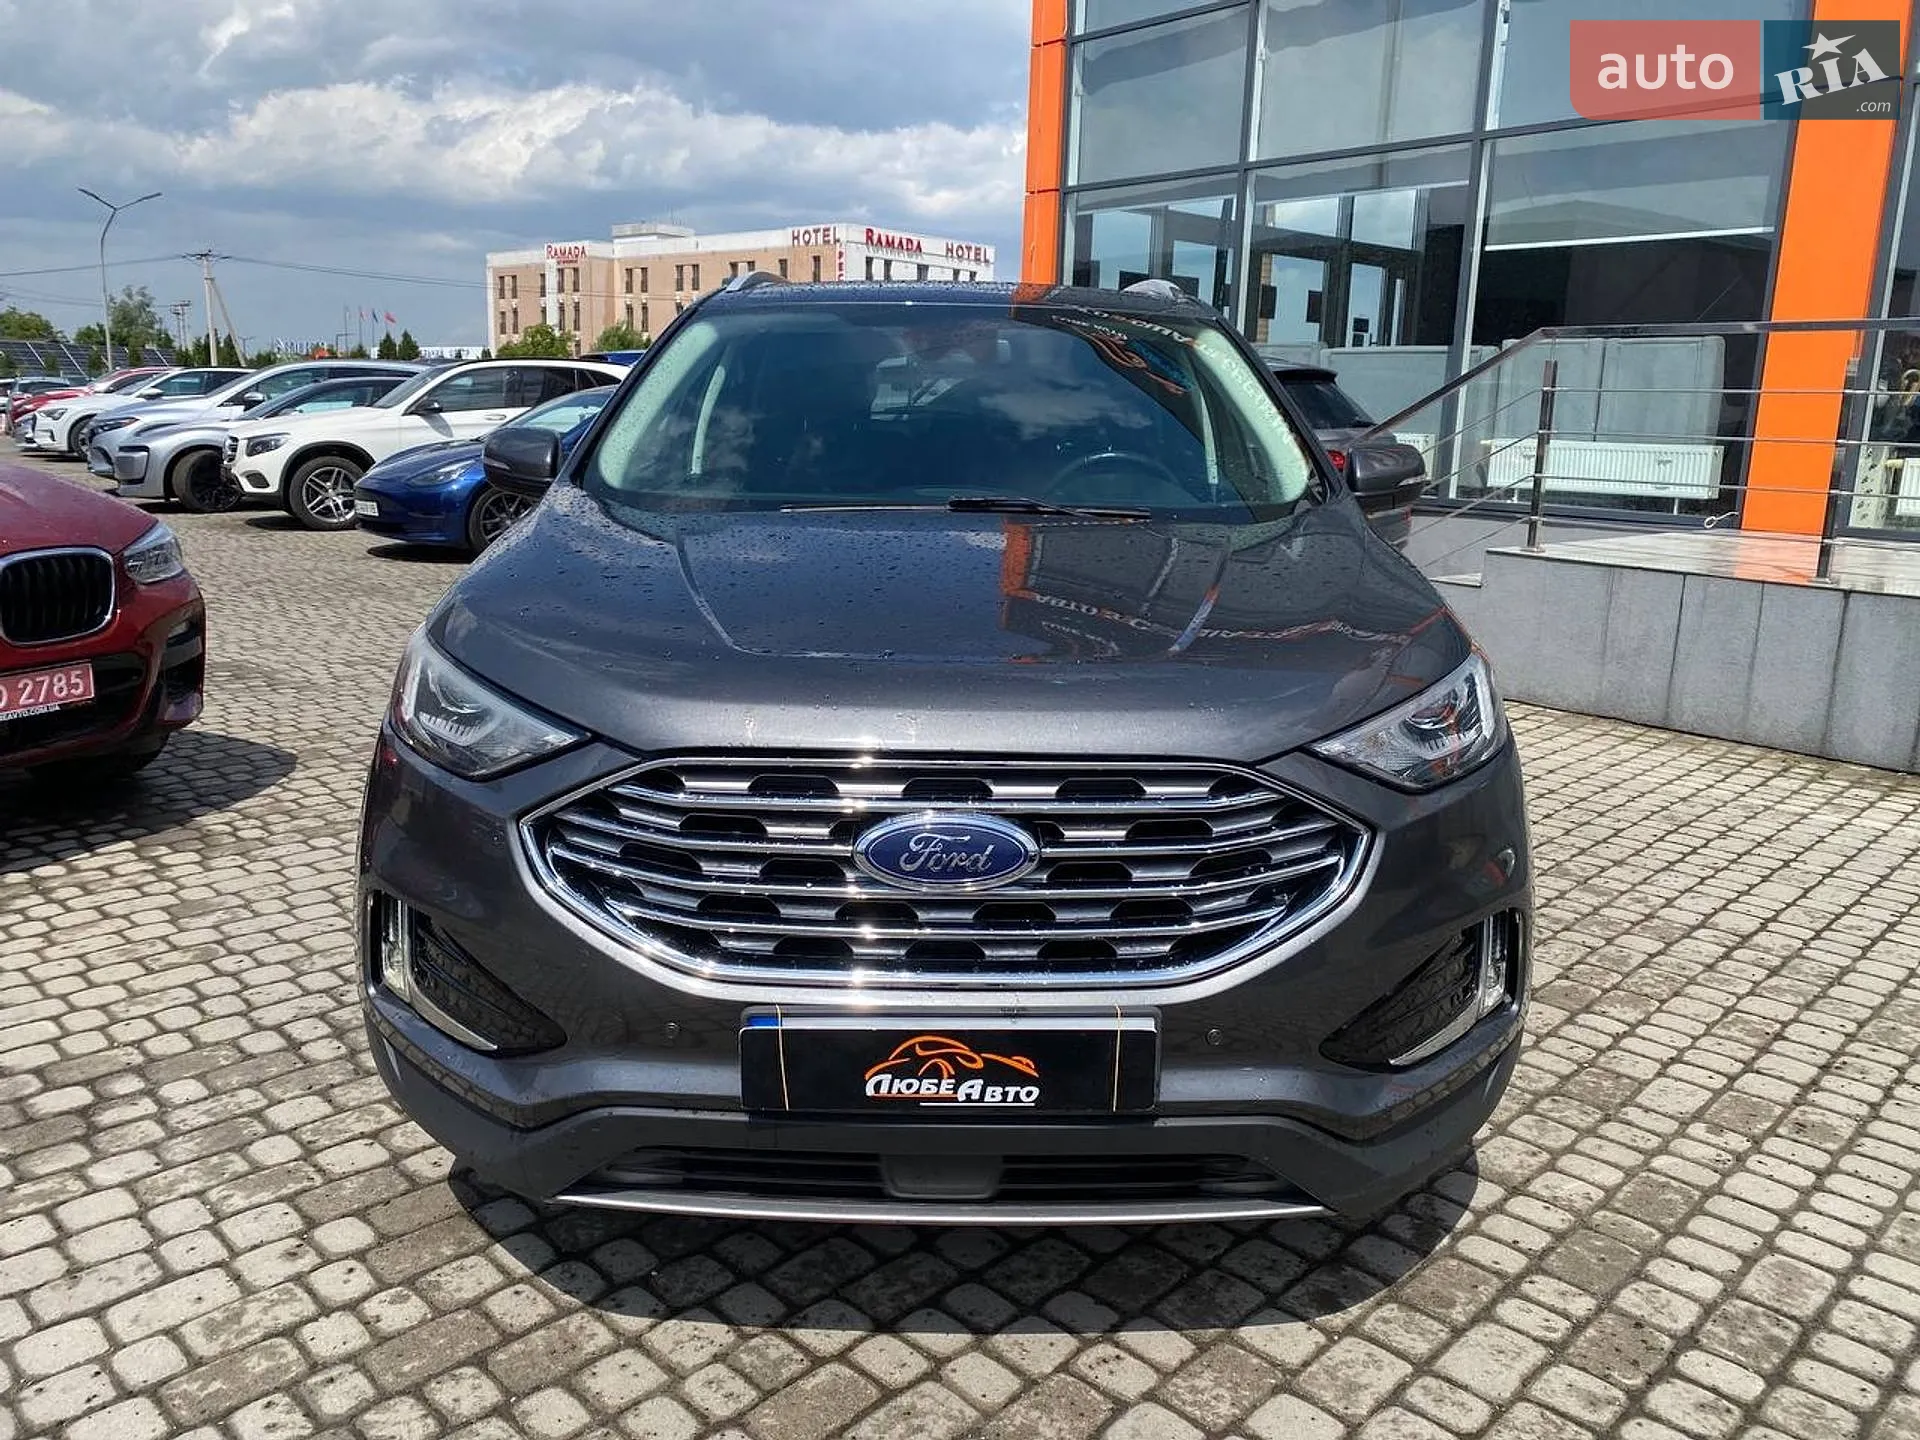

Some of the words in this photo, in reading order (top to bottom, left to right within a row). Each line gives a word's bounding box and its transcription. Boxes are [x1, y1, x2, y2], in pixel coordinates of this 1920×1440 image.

[546, 244, 588, 260] RAMADA
[792, 226, 841, 247] HOTEL
[865, 228, 923, 253] RAMADA
[945, 242, 990, 263] HOTEL
[18, 670, 84, 704] 2785
[900, 832, 996, 873] Ford
